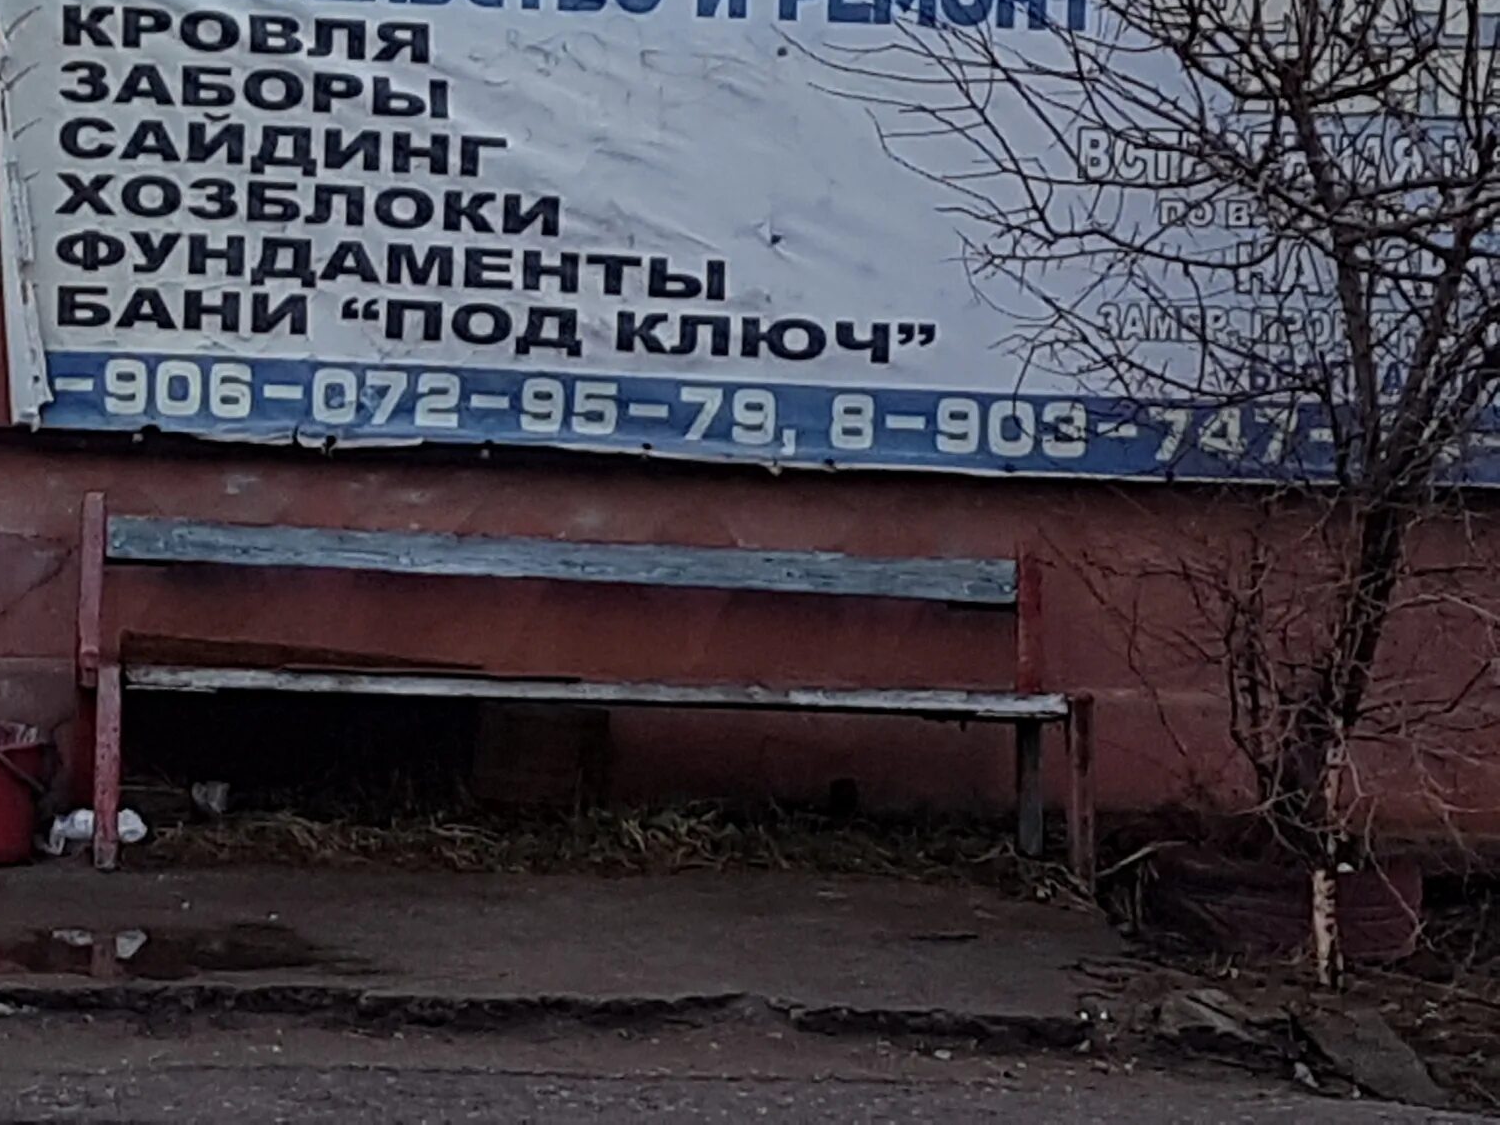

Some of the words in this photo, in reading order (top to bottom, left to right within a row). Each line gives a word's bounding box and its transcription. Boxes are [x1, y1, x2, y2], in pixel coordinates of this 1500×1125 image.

[62, 5, 431, 64] КРОВЛЯ
[59, 61, 449, 119] ЗАБОРЫ
[58, 113, 508, 177] САЙДИНГ
[55, 173, 560, 237] ХОЗБЛОКИ
[55, 230, 727, 301] ФУНДАМЕНТЫ
[56, 286, 309, 336] БАНИ
